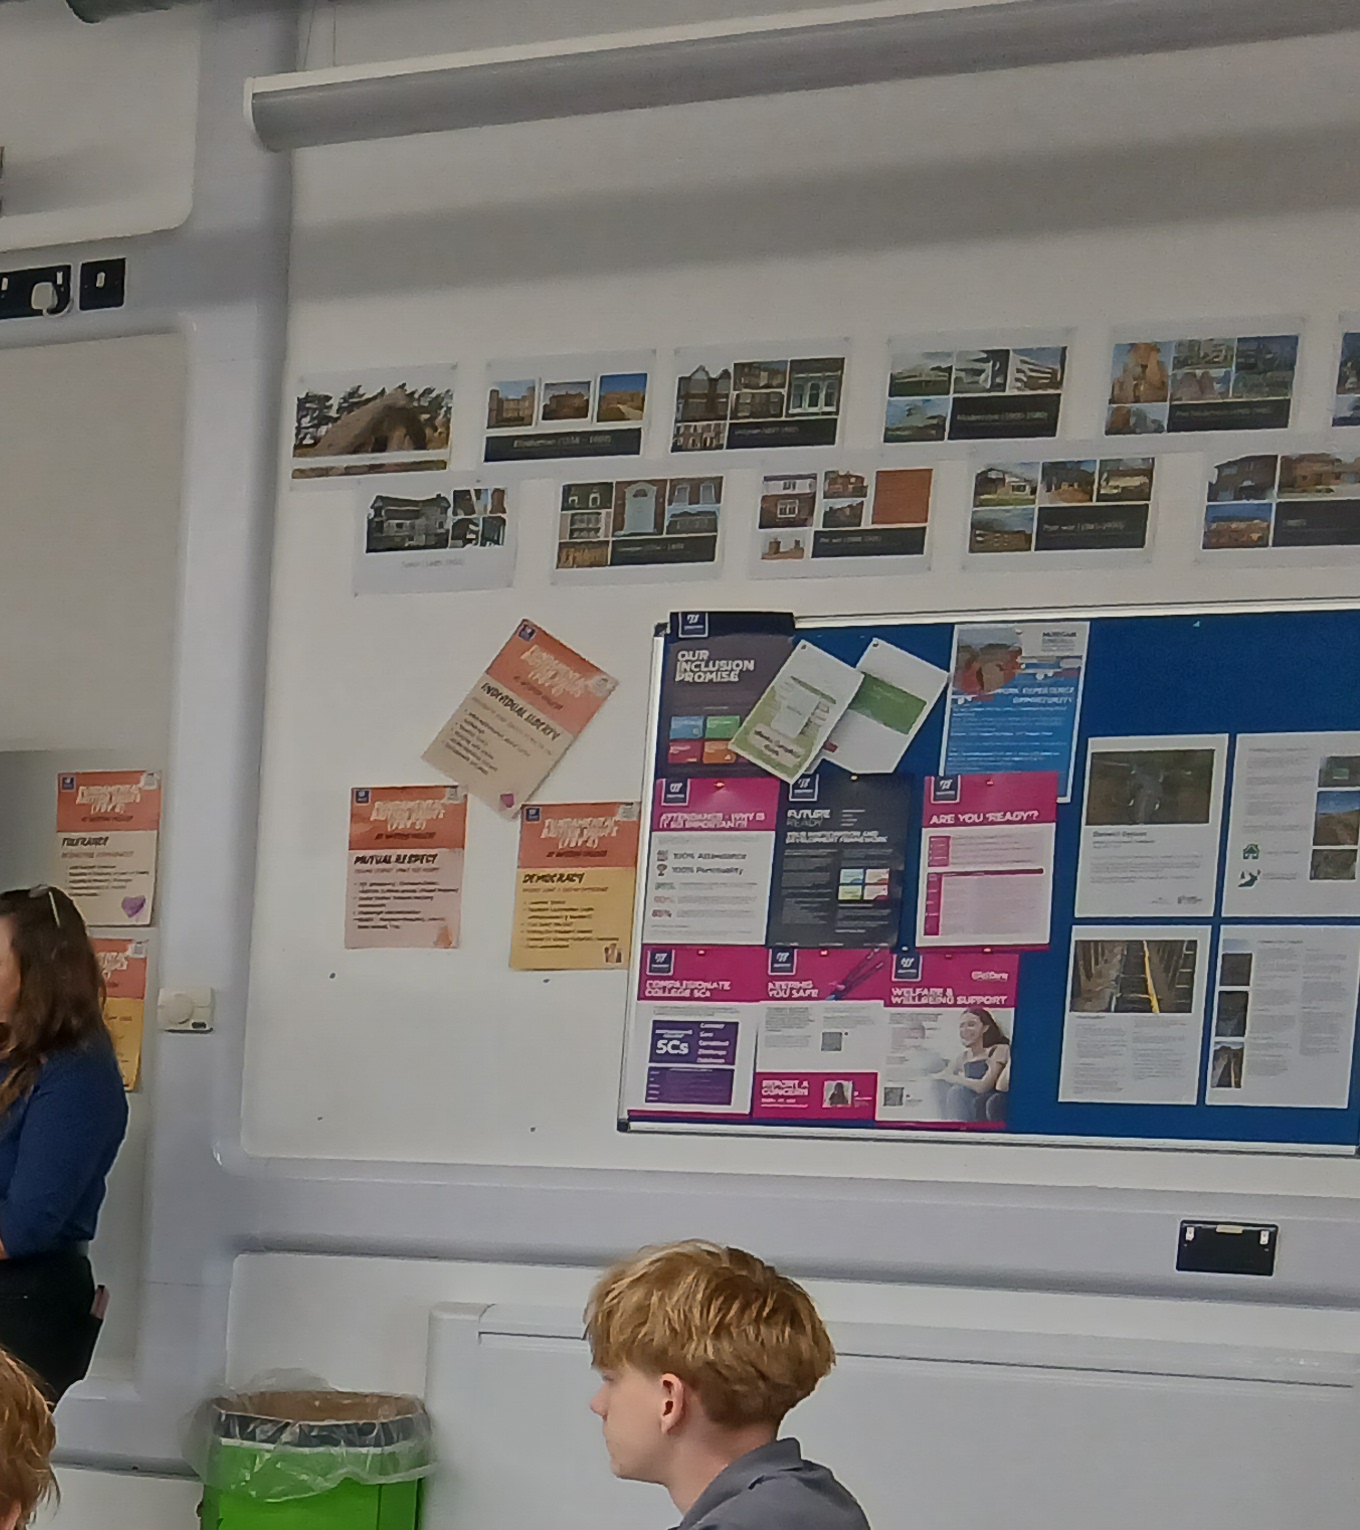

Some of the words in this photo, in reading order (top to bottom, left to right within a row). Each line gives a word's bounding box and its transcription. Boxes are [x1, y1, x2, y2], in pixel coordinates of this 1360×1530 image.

[677, 650, 710, 661] OUR
[676, 660, 755, 672] INCLUSION
[675, 671, 740, 682] PROMISE
[787, 809, 831, 818] FUTURE
[930, 814, 955, 824] ARE
[958, 813, 983, 823] YOU
[354, 854, 392, 865] MUTUAL
[522, 872, 586, 884] DEMOCRACY
[645, 988, 691, 997] COLLEGE
[768, 988, 791, 998] YOU
[792, 988, 819, 998] SAFE
[891, 987, 944, 996] WELFARE
[891, 995, 954, 1004] WELLBEING
[956, 995, 1007, 1005] SUPPORT
